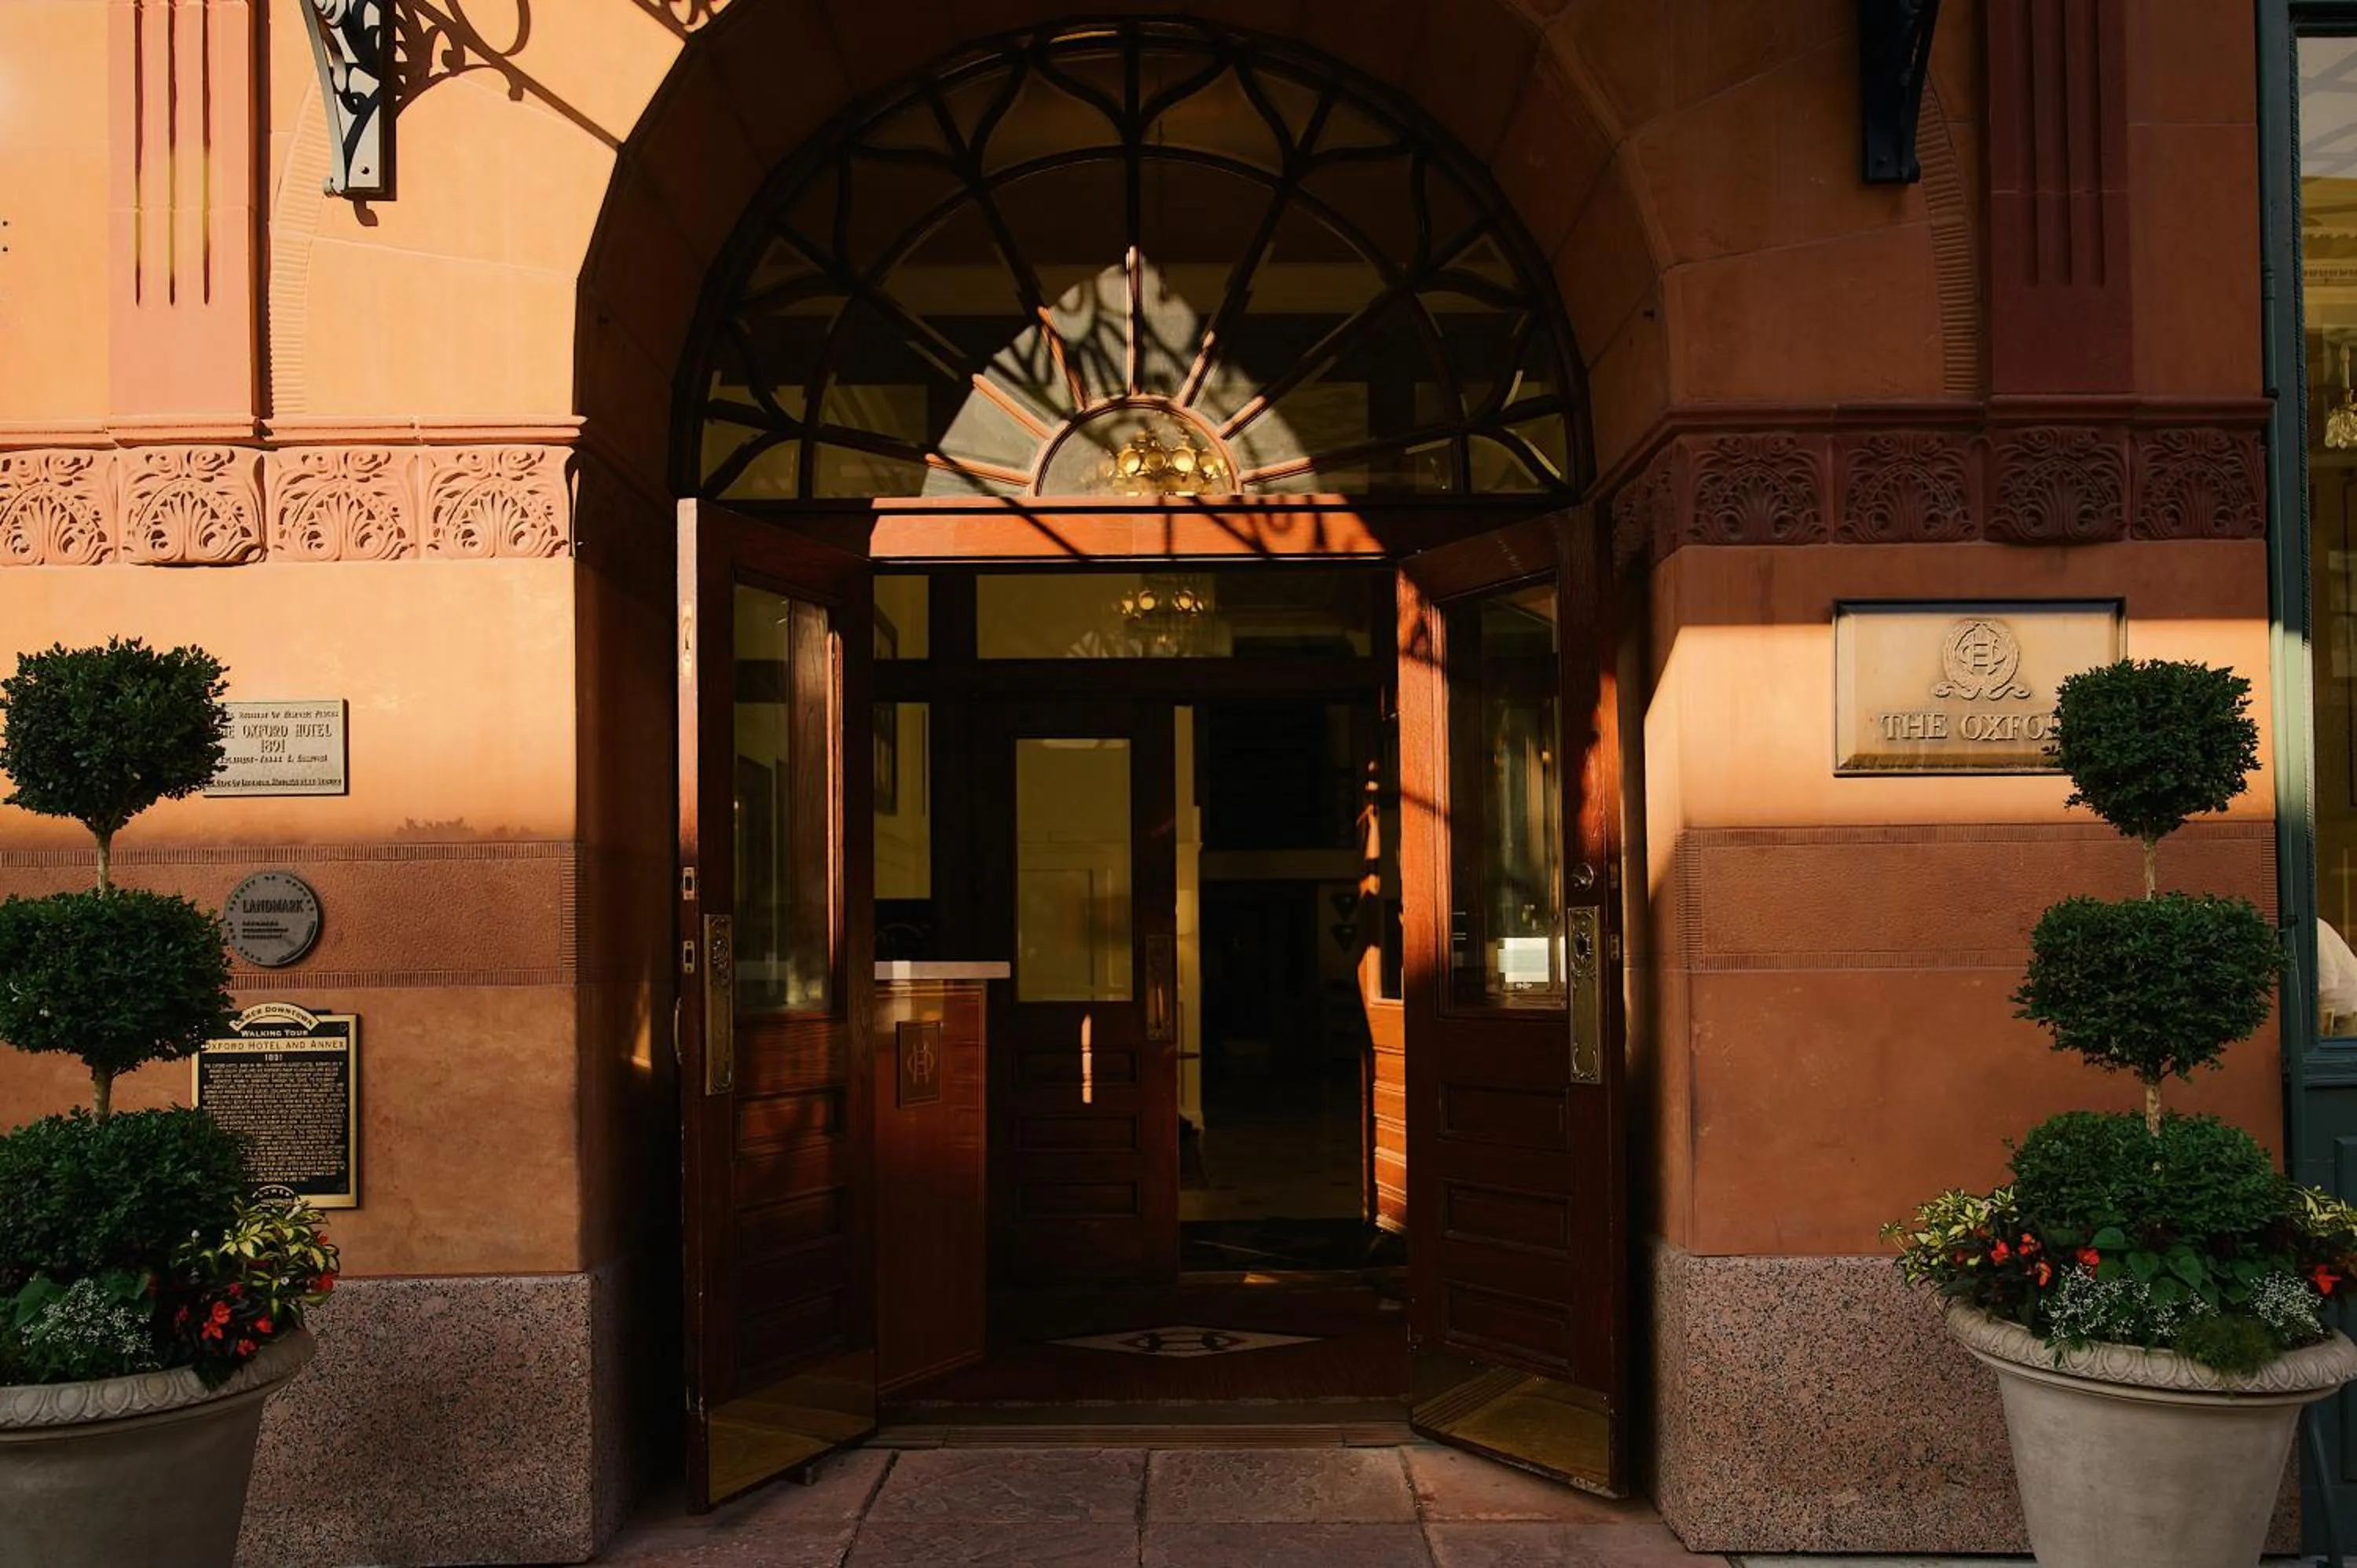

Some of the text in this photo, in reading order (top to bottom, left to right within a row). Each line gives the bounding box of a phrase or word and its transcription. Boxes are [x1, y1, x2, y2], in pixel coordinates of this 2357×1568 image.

[243, 724, 288, 738] OXFORD
[295, 724, 332, 738] HOTEL
[1882, 713, 2062, 742] THE OXFOR
[260, 739, 286, 753] 1891
[242, 898, 305, 914] LANDMARK
[265, 1006, 313, 1027] DOWNTOWN
[240, 1028, 309, 1038] WALKING TOUR
[206, 1039, 345, 1050] OXFORD HOTEL AND ANNEX
